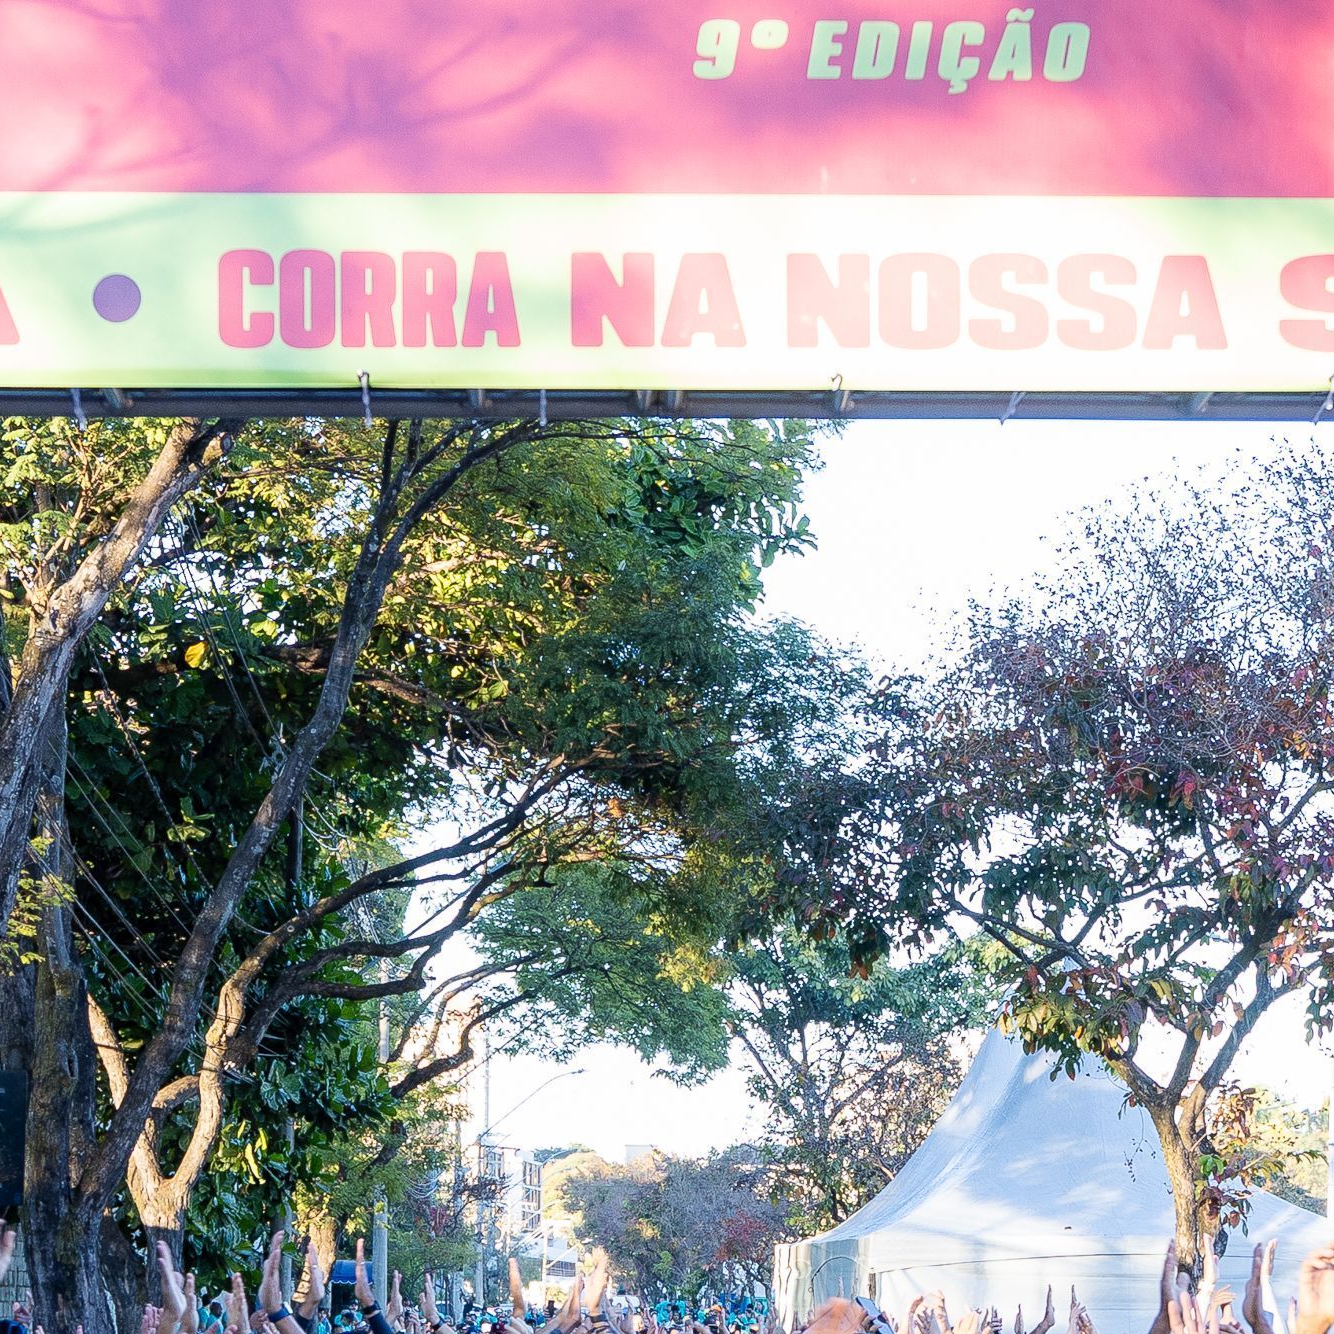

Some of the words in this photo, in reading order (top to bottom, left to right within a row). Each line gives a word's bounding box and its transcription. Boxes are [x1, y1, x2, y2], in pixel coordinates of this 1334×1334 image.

[806, 7, 1091, 94] EDIÇÃO
[217, 249, 522, 348] CORRA
[570, 251, 748, 348] NA
[785, 252, 1229, 350] NOSSA
